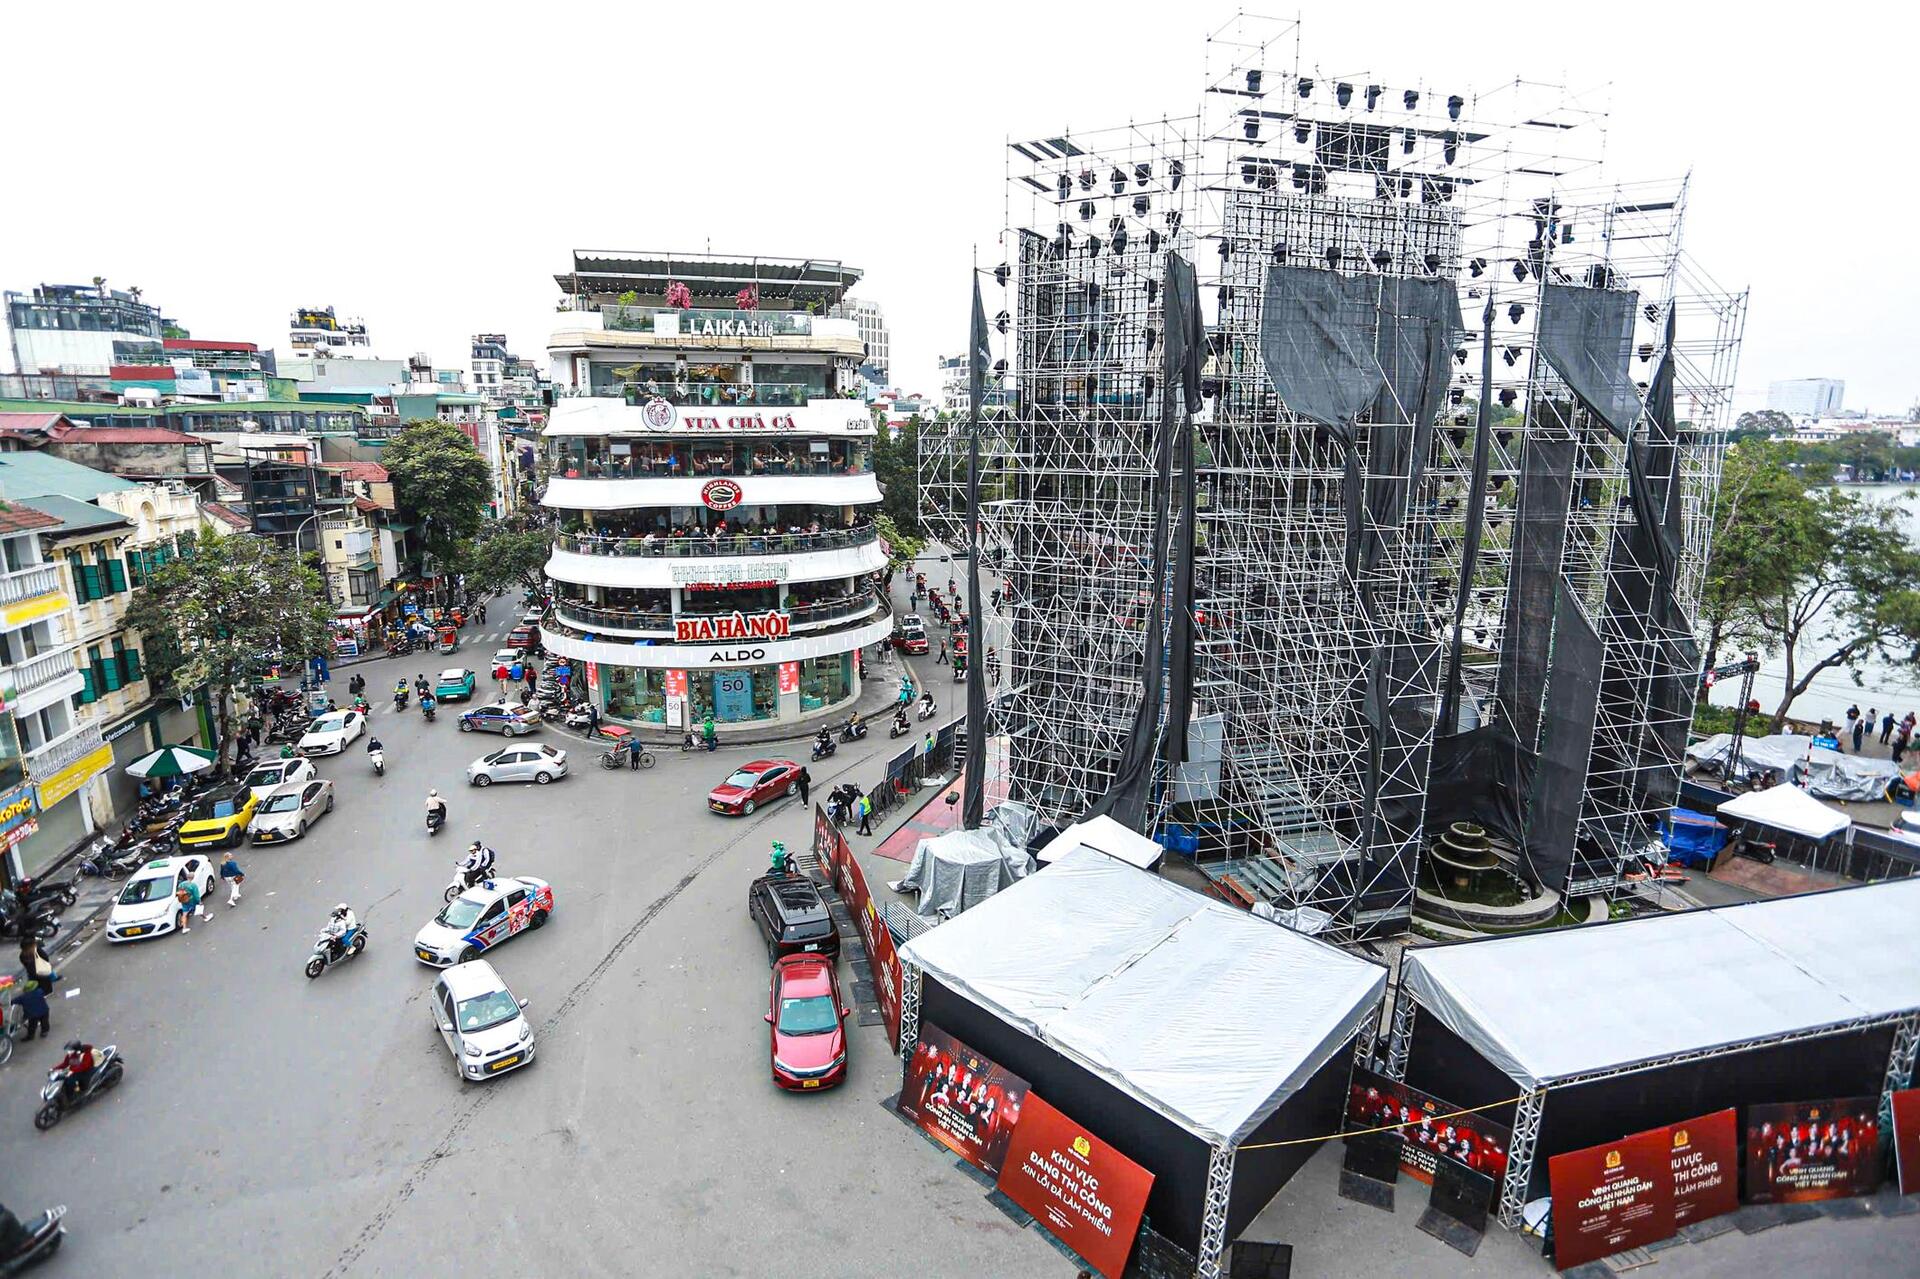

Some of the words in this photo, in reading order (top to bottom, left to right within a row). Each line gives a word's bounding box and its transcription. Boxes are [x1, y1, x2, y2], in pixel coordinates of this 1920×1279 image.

[690, 319, 749, 336] LAIKA
[751, 320, 774, 337] Café
[833, 356, 855, 370] LAIKA
[682, 416, 721, 430] VUA
[771, 412, 797, 430] CÁ
[703, 480, 741, 495] HIGHLANDS
[708, 500, 738, 510] COFFEE
[676, 620, 713, 640] BIA
[715, 614, 748, 639] HÀ
[750, 612, 789, 640] NỘI
[709, 649, 765, 662] ALDO
[722, 679, 744, 692] 50
[105, 720, 136, 742] Vietcombank
[952, 1113, 974, 1132] QUANG
[950, 1128, 966, 1142] NAM
[1682, 1152, 1703, 1168] VỰC
[1051, 1149, 1074, 1173] KHU
[1075, 1165, 1098, 1191] VỰC
[1673, 1169, 1690, 1183] THI
[1690, 1162, 1718, 1178] CÔNG
[1021, 1161, 1037, 1179] XIN
[1036, 1173, 1051, 1190] LỖI
[1062, 1193, 1082, 1214] LÀM
[1029, 1150, 1060, 1180] ĐANG
[1061, 1172, 1079, 1195] THI
[1079, 1188, 1113, 1220] CÔNG
[1591, 1185, 1611, 1197] VINH
[1611, 1176, 1640, 1191] QUANG
[1578, 1197, 1602, 1209] CÔNG
[1602, 1193, 1614, 1202] AN
[1614, 1186, 1637, 1199] NHÂN
[1636, 1180, 1653, 1192] DÂN
[1598, 1200, 1615, 1212] VIỆT
[1616, 1194, 1635, 1207] NAM
